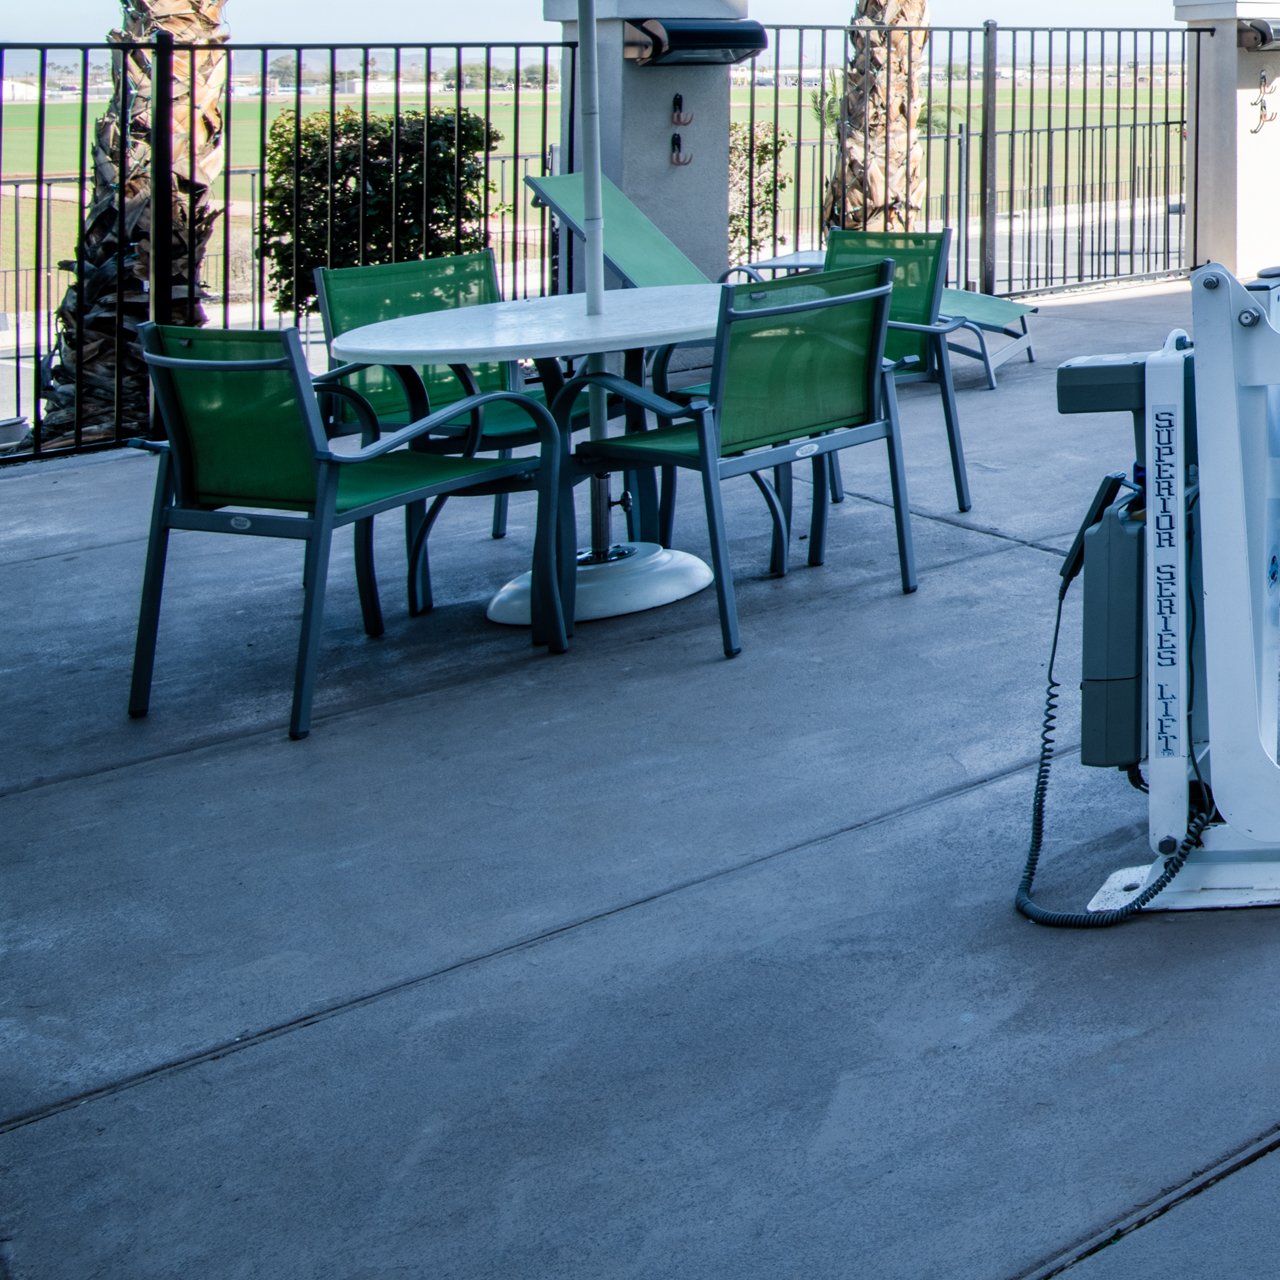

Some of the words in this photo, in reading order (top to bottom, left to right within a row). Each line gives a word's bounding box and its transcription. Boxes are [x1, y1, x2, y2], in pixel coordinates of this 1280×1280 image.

[1155, 412, 1176, 548] SUPERIOR
[1156, 564, 1177, 667] SERIES
[1157, 683, 1177, 752] LIFT
